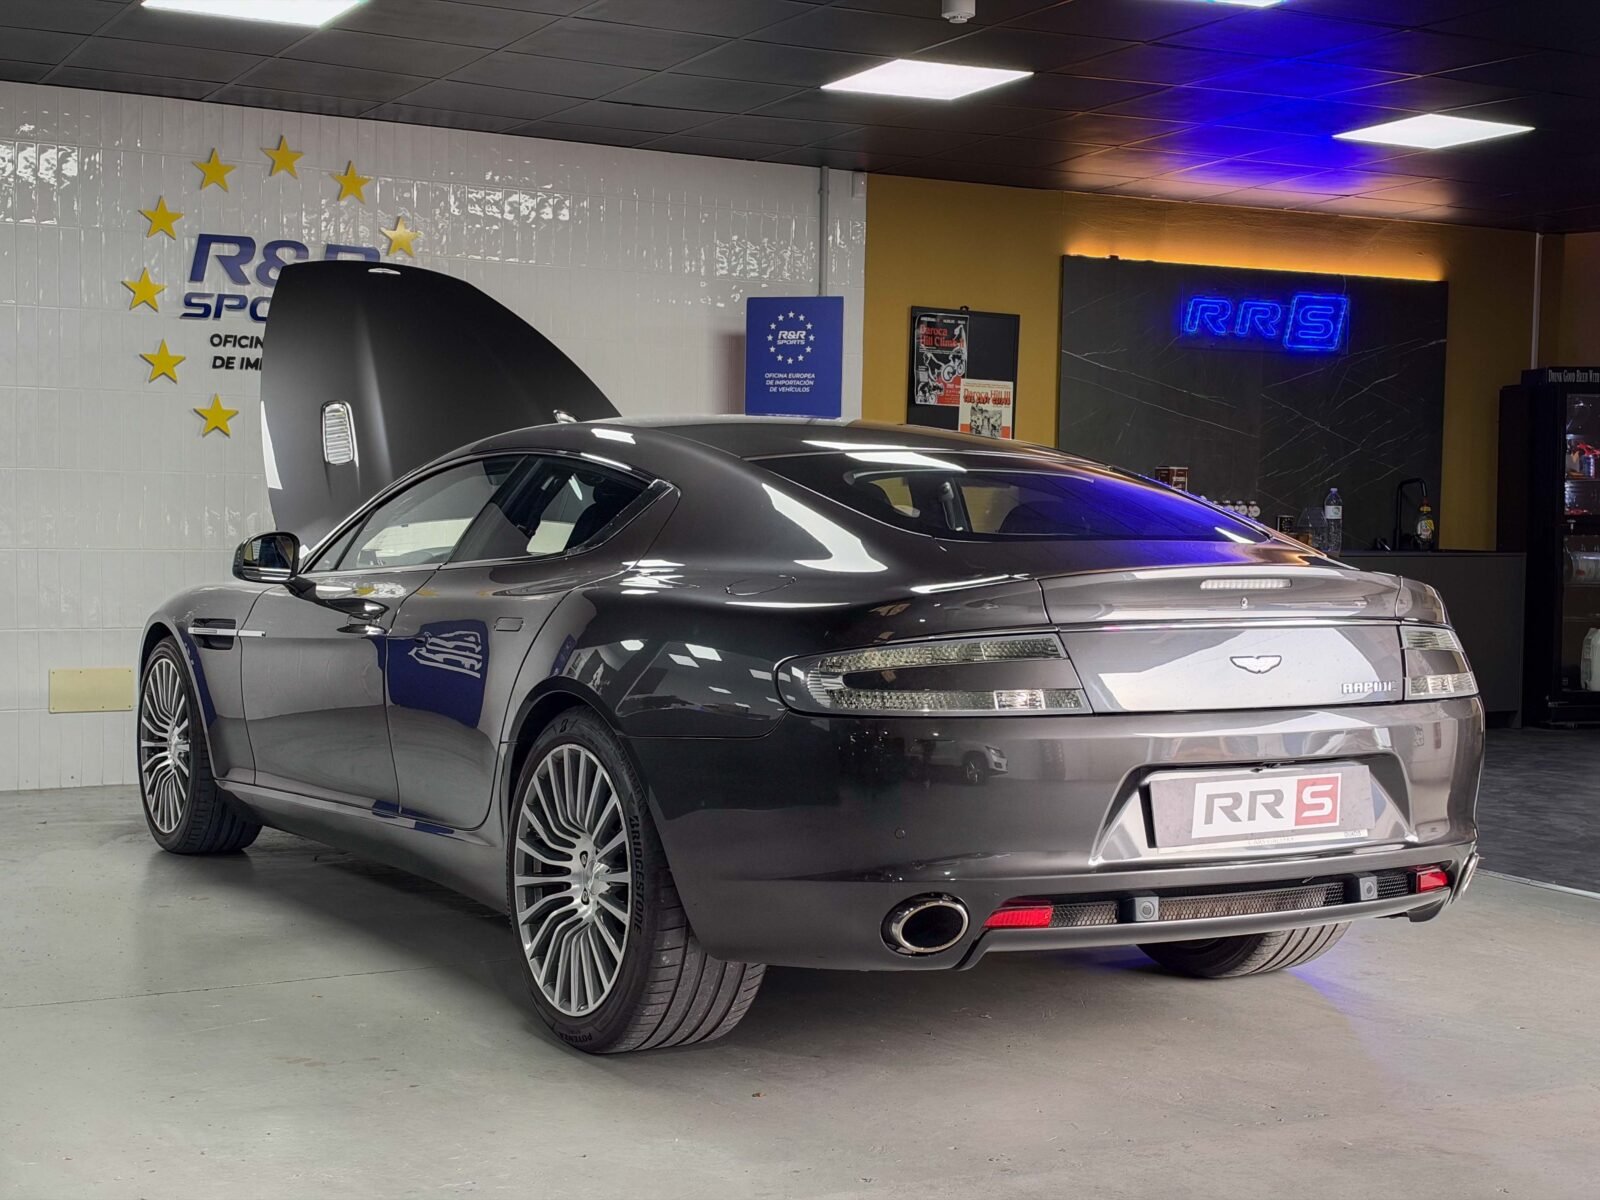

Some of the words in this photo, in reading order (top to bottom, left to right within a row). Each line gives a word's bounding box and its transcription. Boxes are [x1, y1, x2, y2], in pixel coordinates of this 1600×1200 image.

[180, 292, 272, 324] SPO
[1184, 296, 1336, 342] RRS
[209, 333, 264, 349] OFICIN
[778, 331, 806, 339] R&R
[212, 355, 236, 370] DE
[1203, 784, 1334, 826] RRS
[629, 815, 645, 935] BRIDGESTONE
